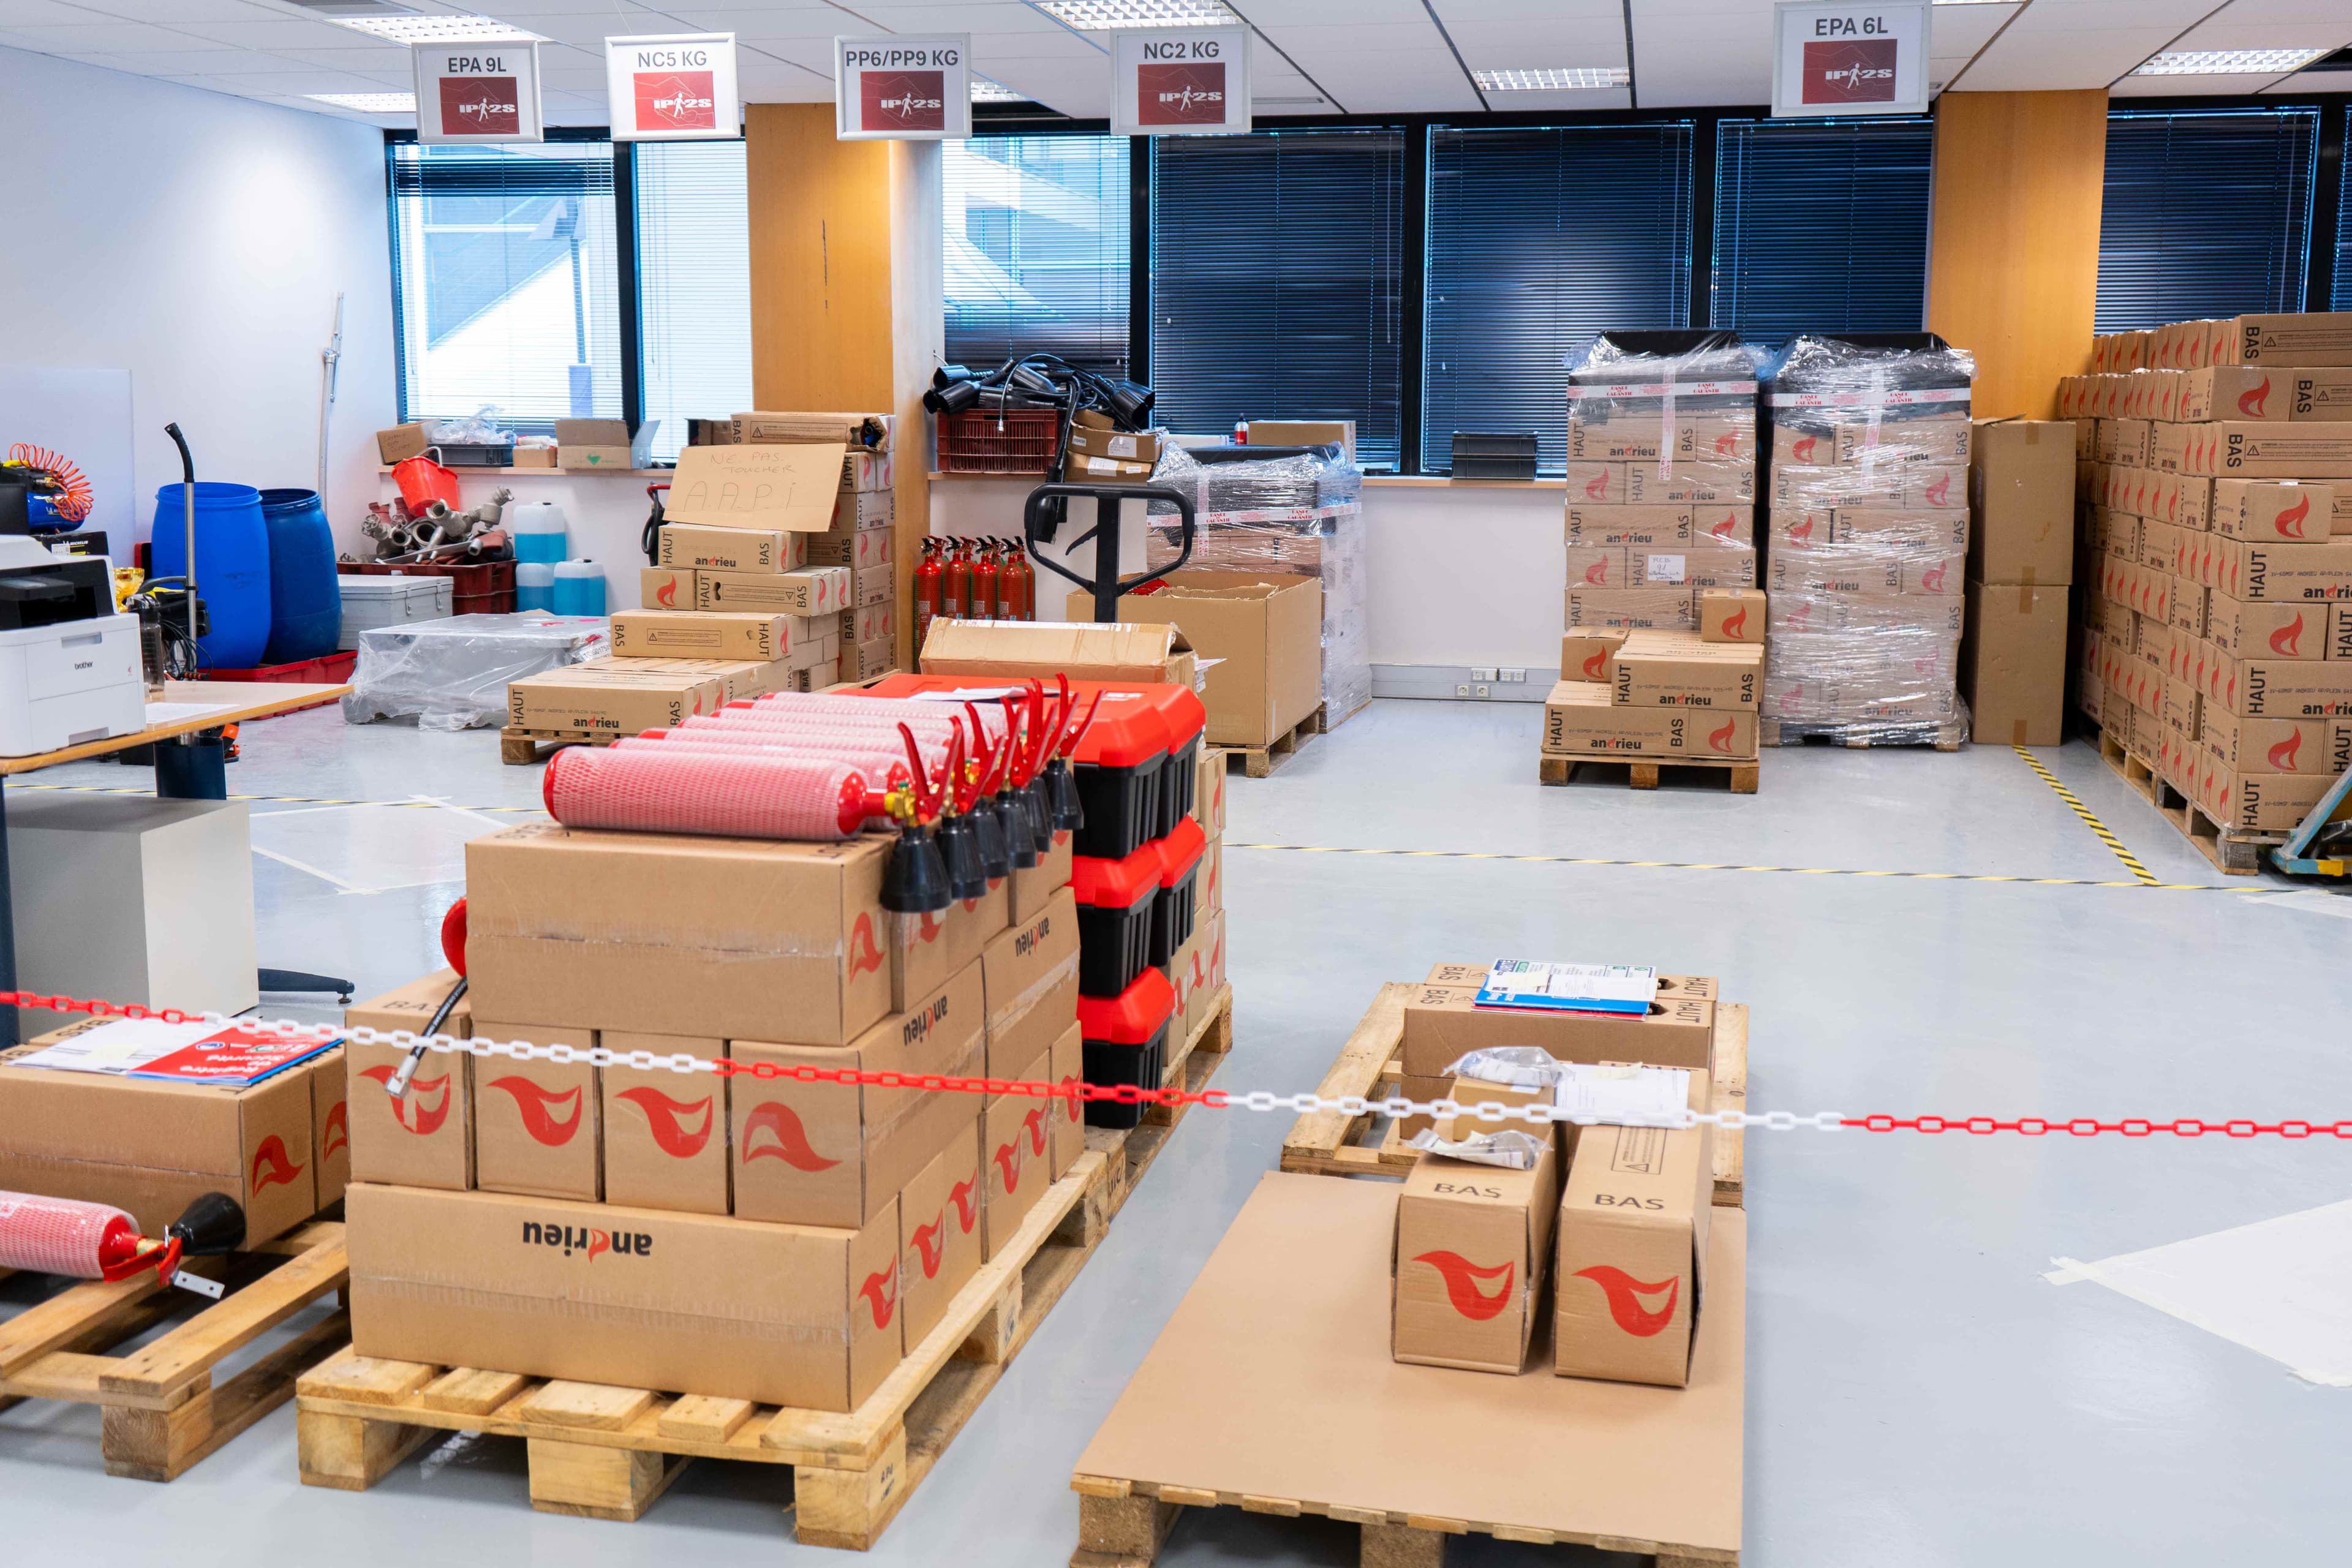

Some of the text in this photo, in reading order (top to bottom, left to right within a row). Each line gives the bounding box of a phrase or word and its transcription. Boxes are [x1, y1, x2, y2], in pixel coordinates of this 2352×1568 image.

[1815, 17, 1888, 36] EPA 6L
[638, 50, 707, 68] NC5 KG
[846, 49, 959, 67] PP6/PP9 KG
[1144, 41, 1219, 59] NC2 KG
[448, 56, 507, 73] EPA 9L
[2244, 326, 2260, 359] BAS
[2297, 380, 2313, 413] BAS
[733, 420, 741, 443] BAS
[1573, 422, 1585, 456] HAUT
[1681, 428, 1693, 451] BAS
[1956, 431, 1967, 456] BAS
[1610, 445, 1656, 456] andrieu
[2227, 434, 2243, 467] BAS
[843, 456, 853, 488] HAUT
[1741, 471, 1752, 495] BAS
[1632, 467, 1643, 502] HAUT
[1669, 489, 1715, 500] andrieu
[1570, 509, 1582, 544] HAUT
[1606, 531, 1653, 543] andrieu
[1678, 514, 1689, 538] BAS
[1953, 519, 1965, 544] BAS
[662, 530, 673, 564] HAUT
[759, 542, 770, 565] BAS
[842, 538, 851, 562] BAS
[695, 555, 736, 567] andrieu
[1632, 552, 1645, 586] HAUT
[1886, 563, 1898, 586] BAS
[2249, 551, 2267, 598] HAUT
[699, 575, 710, 608] HAUT
[797, 585, 807, 608] BAS
[2303, 582, 2352, 598] andri
[1571, 593, 1582, 627] HAUT
[844, 615, 854, 639] BAS
[1606, 617, 1653, 628] andrieu
[2337, 610, 2352, 658] HAUT
[614, 624, 625, 647] BAS
[758, 623, 770, 657] HAUT
[75, 661, 93, 670] brother
[1618, 664, 1631, 703] HAUT
[1741, 673, 1754, 703] BAS
[2249, 667, 2266, 714] HAUT
[513, 688, 524, 725] HAUT
[1659, 692, 1711, 706] andrieu
[2302, 699, 2352, 716] andri
[573, 716, 619, 728] andrieu
[669, 700, 680, 725] BAS
[1550, 709, 1563, 747] HAUT
[1670, 718, 1684, 748] BAS
[1591, 736, 1642, 750] andrieu
[2333, 726, 2351, 772] HAUT
[2242, 780, 2260, 826] HAUT
[1015, 916, 1050, 957] andrieu
[1442, 966, 1466, 981] BAS
[1420, 989, 1449, 1005] BAS
[1684, 976, 1709, 998] HAUT
[903, 995, 948, 1046] andrieu
[1675, 1001, 1704, 1023] HAUT
[1433, 1182, 1503, 1199] BAS
[1594, 1194, 1665, 1211] BAS
[522, 1221, 653, 1264] andrieu
